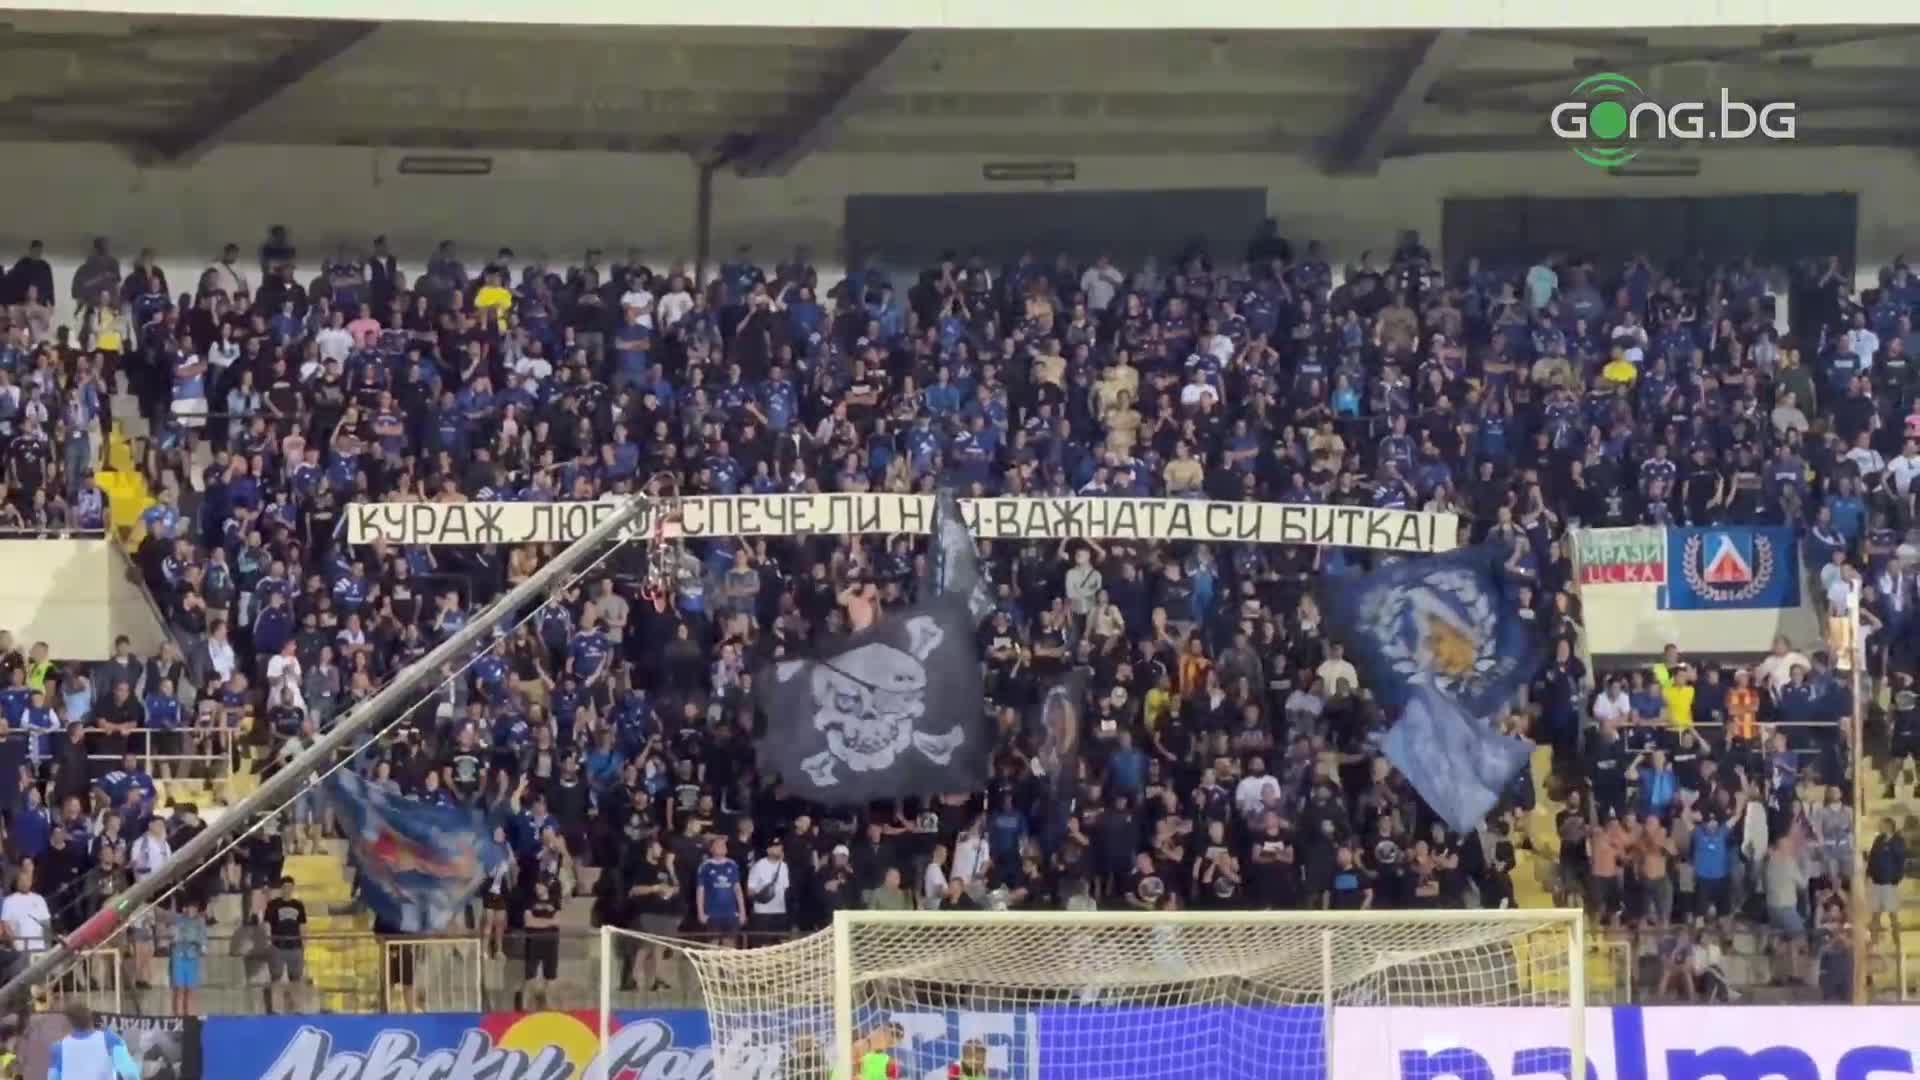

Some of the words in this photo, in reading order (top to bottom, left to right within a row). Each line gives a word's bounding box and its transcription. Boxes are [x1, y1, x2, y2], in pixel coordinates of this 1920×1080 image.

[680, 496, 884, 536] СПЕЧЕЛИ
[1205, 503, 1262, 538] СИ
[1280, 506, 1438, 552] БИТКА!
[1587, 563, 1655, 582] ЦСКА
